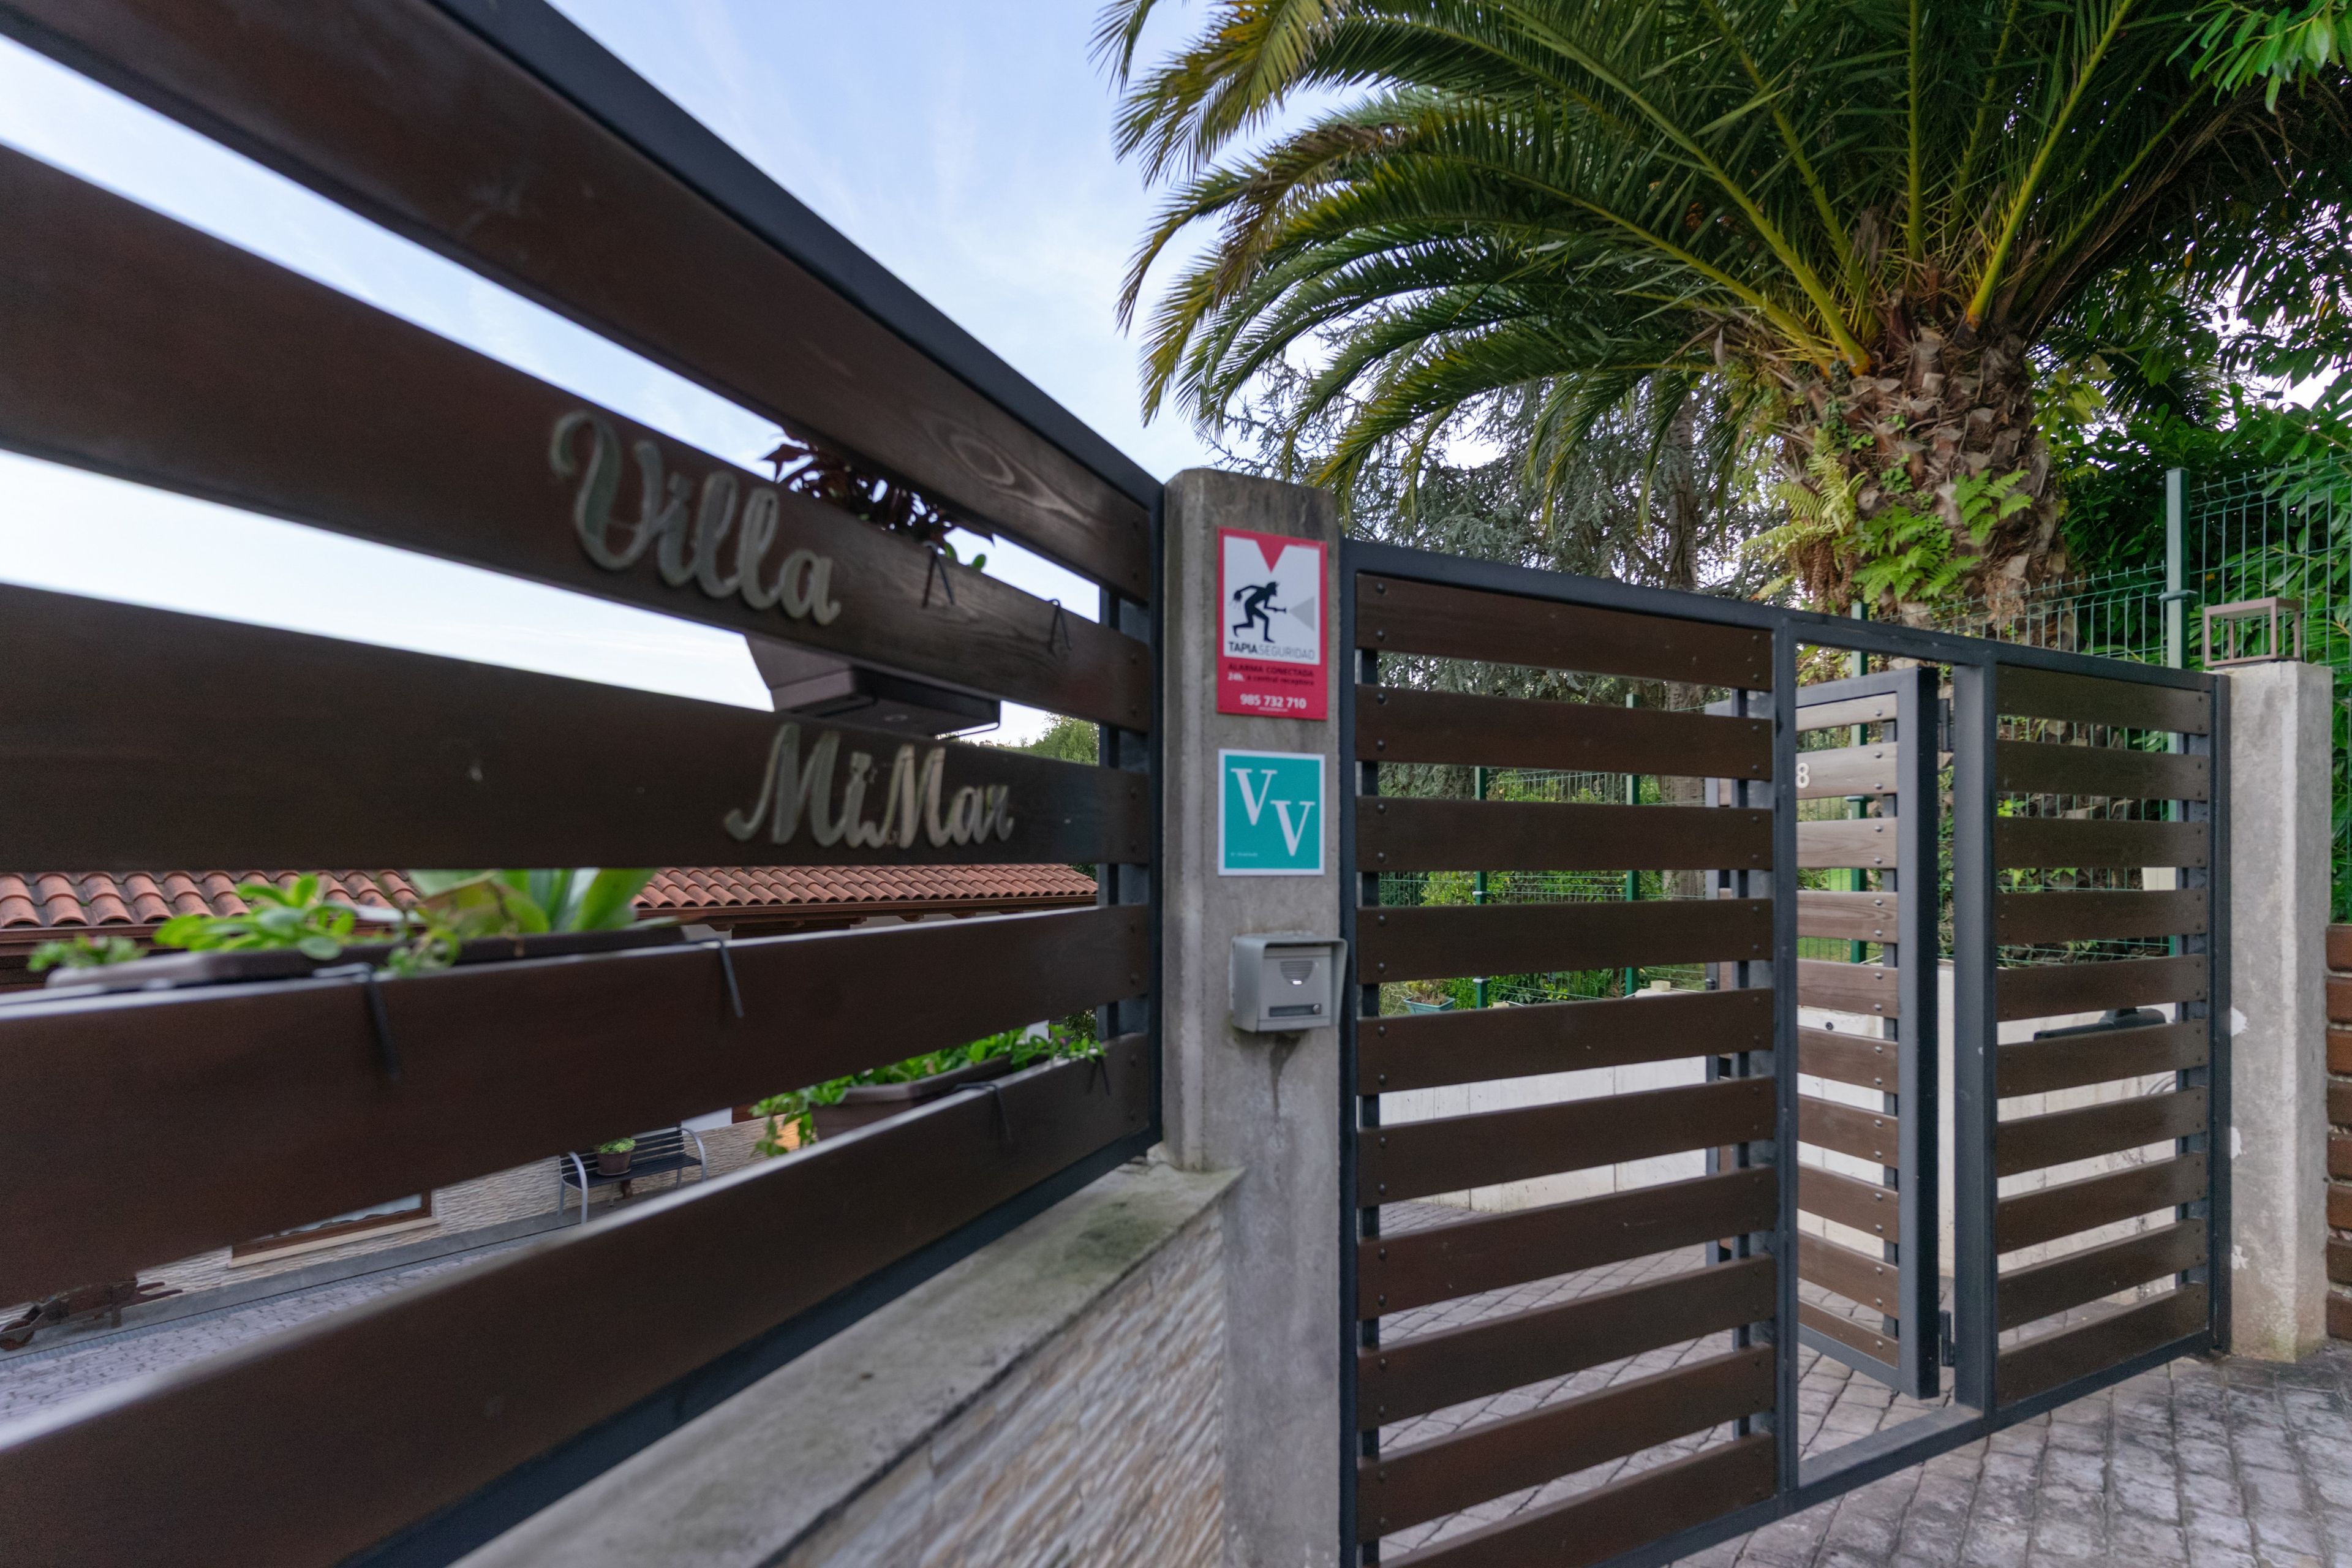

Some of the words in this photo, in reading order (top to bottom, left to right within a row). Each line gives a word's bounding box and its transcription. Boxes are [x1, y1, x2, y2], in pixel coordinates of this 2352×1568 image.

[550, 410, 841, 625] Villa
[1266, 666, 1313, 677] CONECTADA
[1240, 693, 1261, 706] 985
[1264, 695, 1284, 707] 732
[1286, 697, 1307, 709] 710
[1795, 763, 1810, 788] 8
